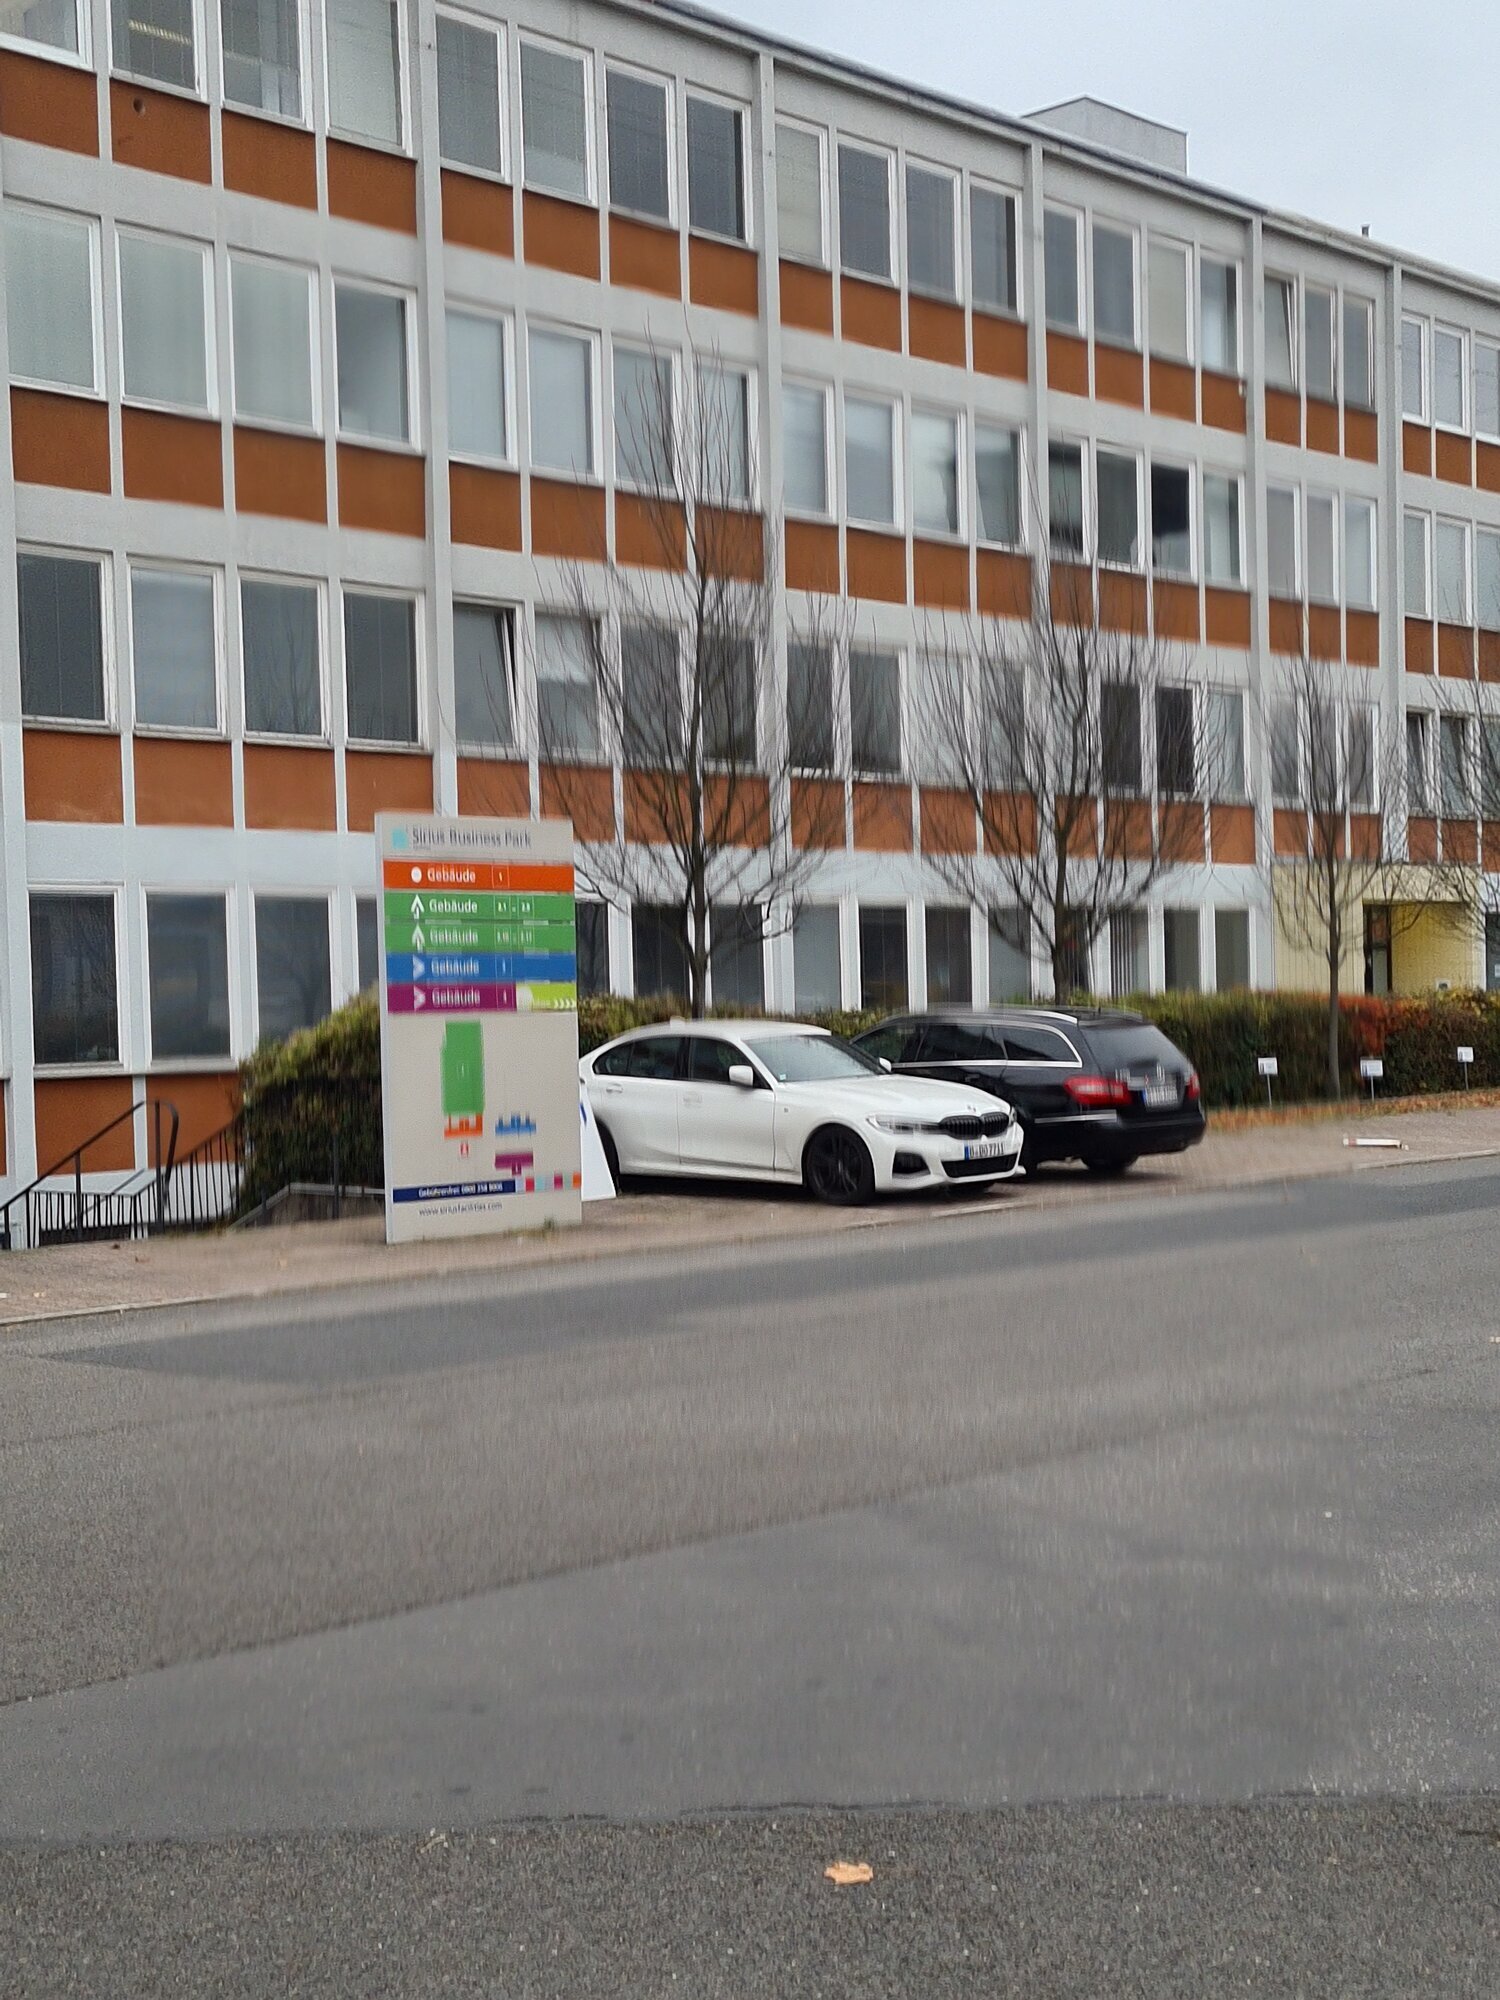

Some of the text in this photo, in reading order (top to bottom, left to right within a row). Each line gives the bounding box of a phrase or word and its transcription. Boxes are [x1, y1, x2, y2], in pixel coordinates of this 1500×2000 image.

[412, 825, 532, 849] Sirius Business Park
[427, 865, 476, 883] Gebäude
[429, 897, 478, 914] Gebäude
[430, 928, 478, 945] Gebäude
[431, 956, 480, 975] Gebäude
[432, 987, 481, 1007] Gebäude
